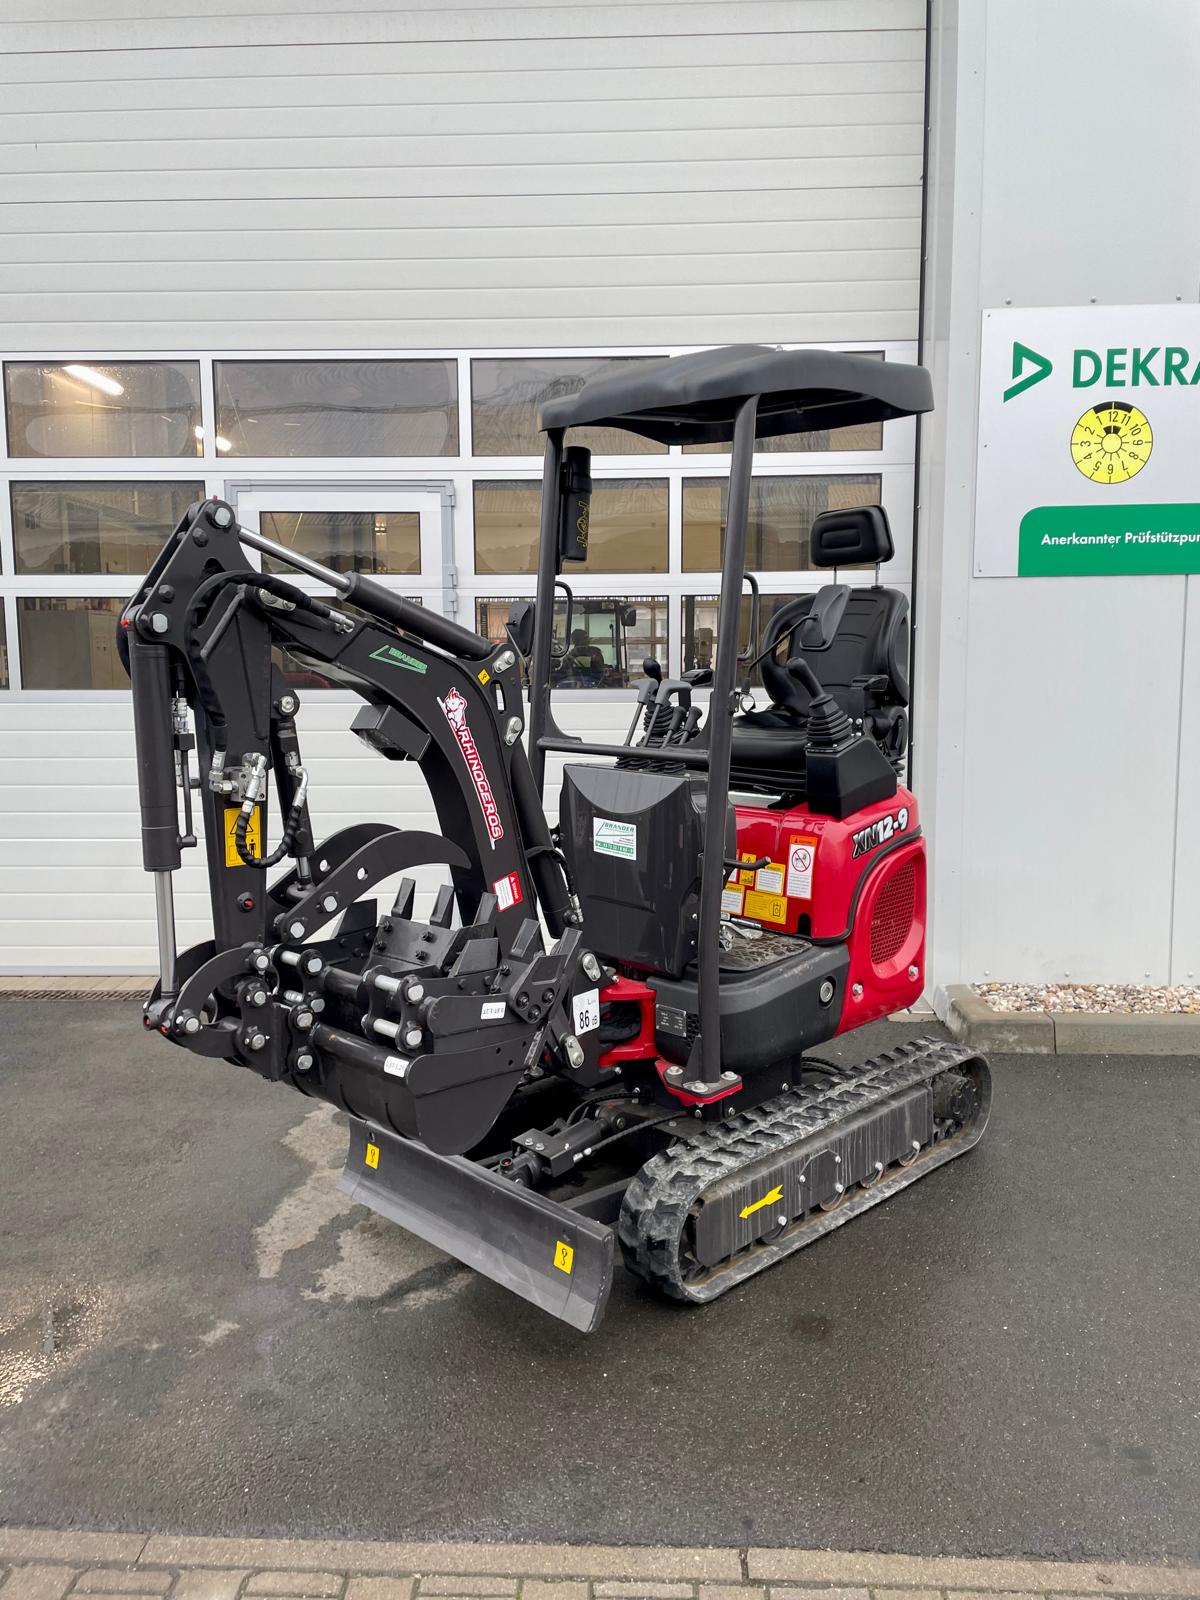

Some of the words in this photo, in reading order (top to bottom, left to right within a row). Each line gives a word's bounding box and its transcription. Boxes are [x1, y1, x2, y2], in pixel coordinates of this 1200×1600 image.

[1072, 346, 1200, 388] DEKR
[1108, 411, 1119, 422] 12
[1121, 414, 1131, 426] 11
[1084, 426, 1095, 435] 2
[1129, 424, 1142, 436] 10
[1083, 452, 1093, 460] 4
[1129, 451, 1139, 460] 8
[1093, 460, 1102, 472] 5
[1107, 463, 1114, 475] 6
[1121, 460, 1129, 471] 7
[1041, 532, 1122, 545] Anerkannter
[457, 727, 503, 839] RHINOCEROS
[852, 807, 909, 859] XN12-9
[579, 1009, 590, 1030] 86
